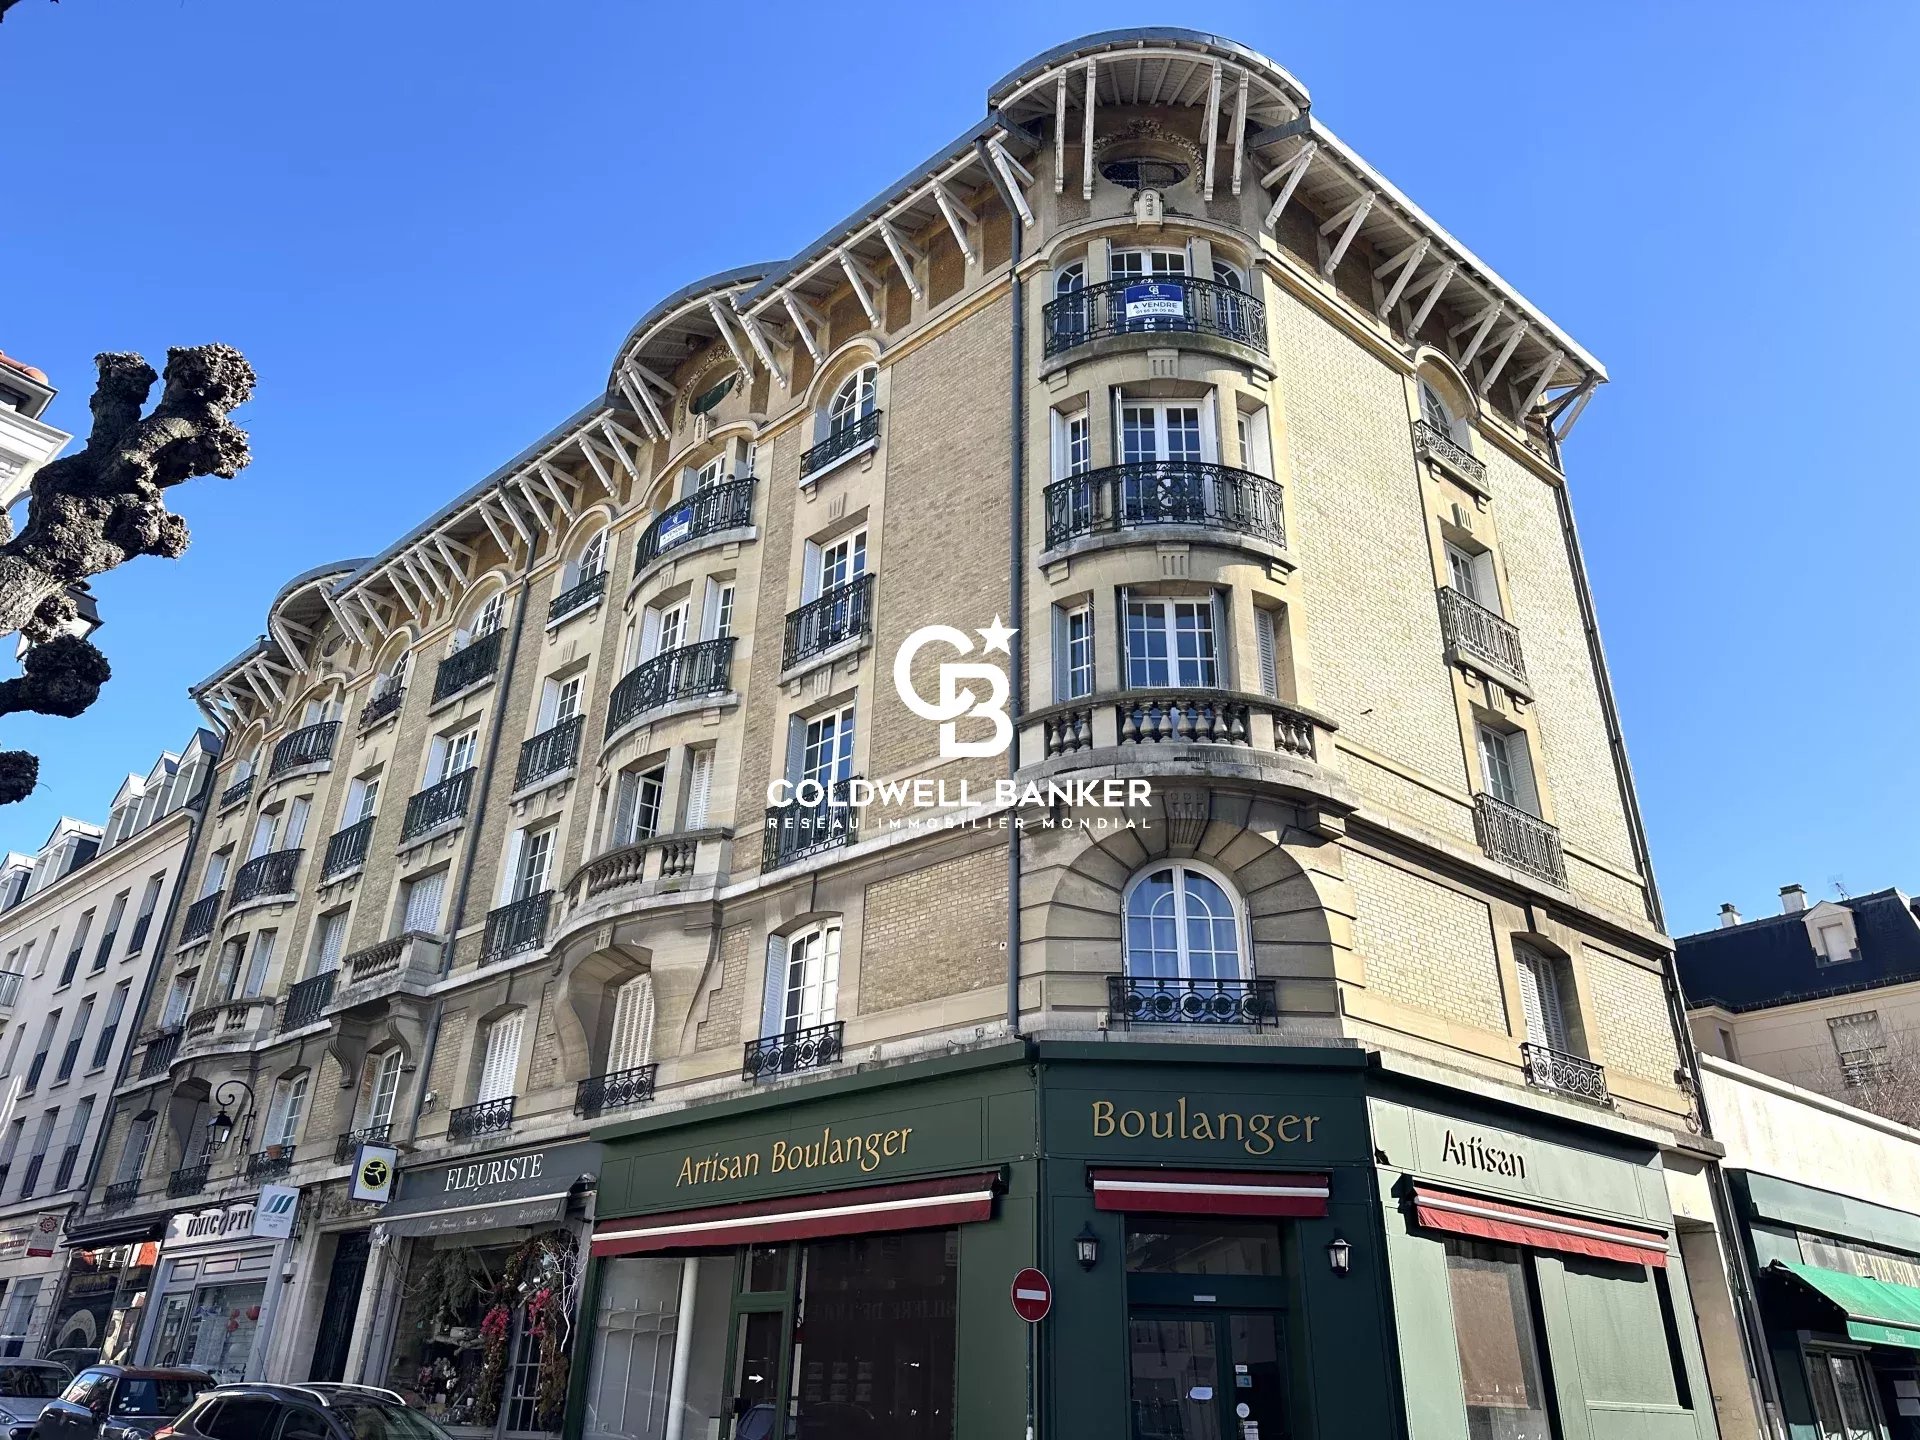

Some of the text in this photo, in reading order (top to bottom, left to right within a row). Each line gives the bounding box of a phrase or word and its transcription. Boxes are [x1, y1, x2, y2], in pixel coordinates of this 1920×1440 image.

[1141, 301, 1178, 309] VENDRE
[1091, 1096, 1321, 1156] Boulanger
[443, 1153, 545, 1192] FLEURISTE
[675, 1126, 913, 1188] Artisan Boulanger
[1442, 1128, 1527, 1180] Artisan
